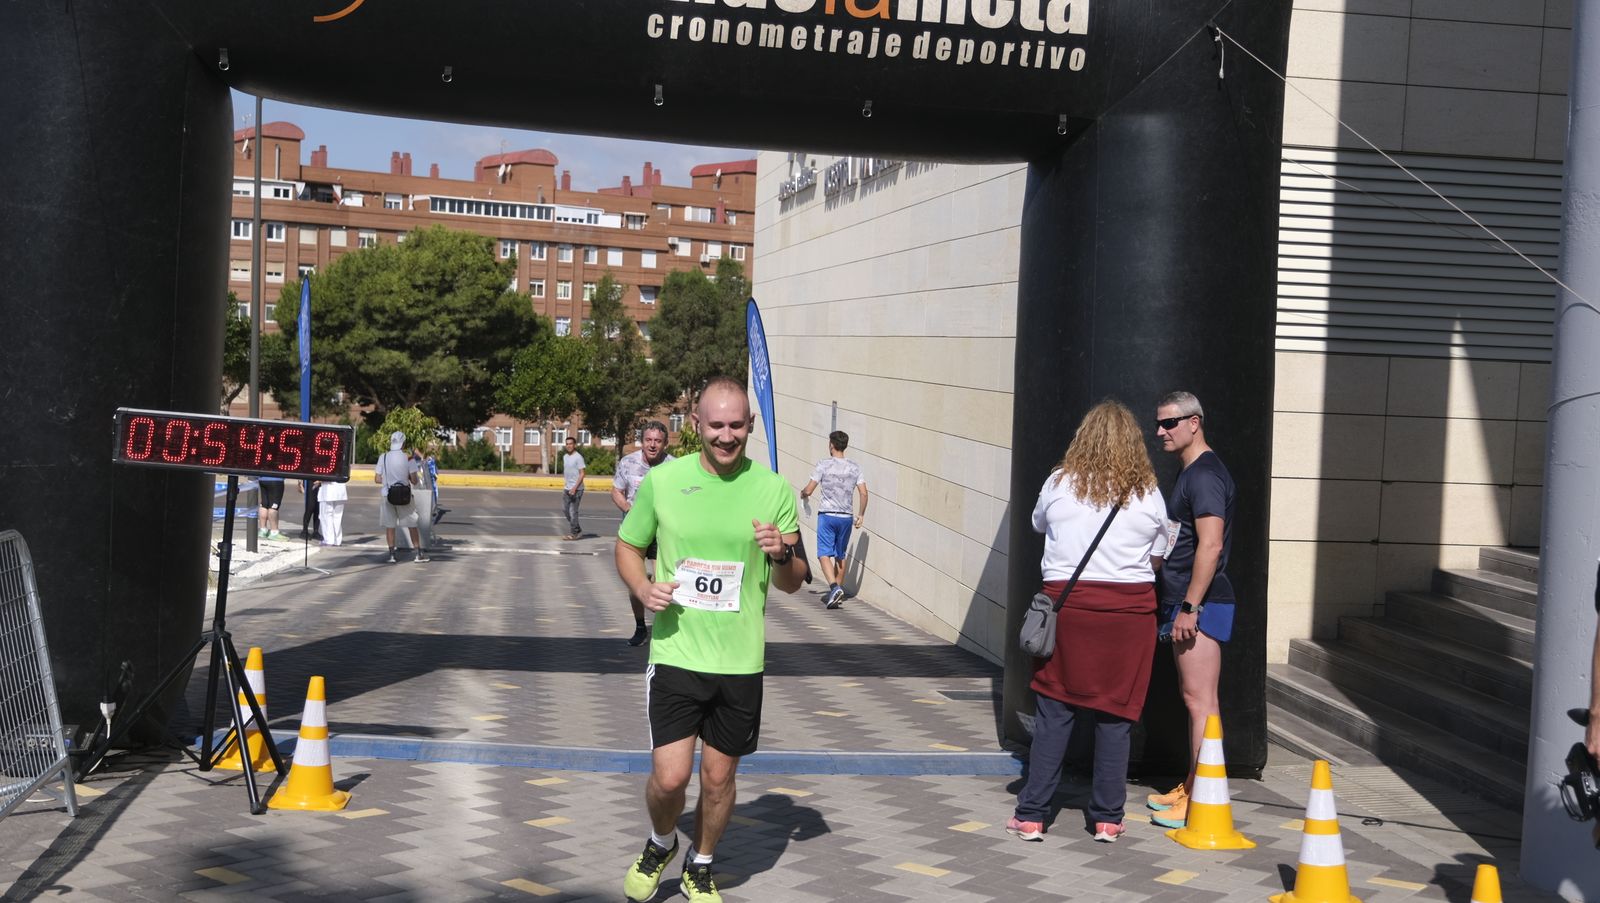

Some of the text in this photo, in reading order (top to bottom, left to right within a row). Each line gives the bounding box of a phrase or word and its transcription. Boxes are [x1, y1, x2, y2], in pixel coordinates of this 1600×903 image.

[647, 13, 902, 59] cronometraje
[912, 31, 1087, 72] deportivo
[126, 416, 340, 474] 00:54:59
[695, 576, 722, 594] 60
